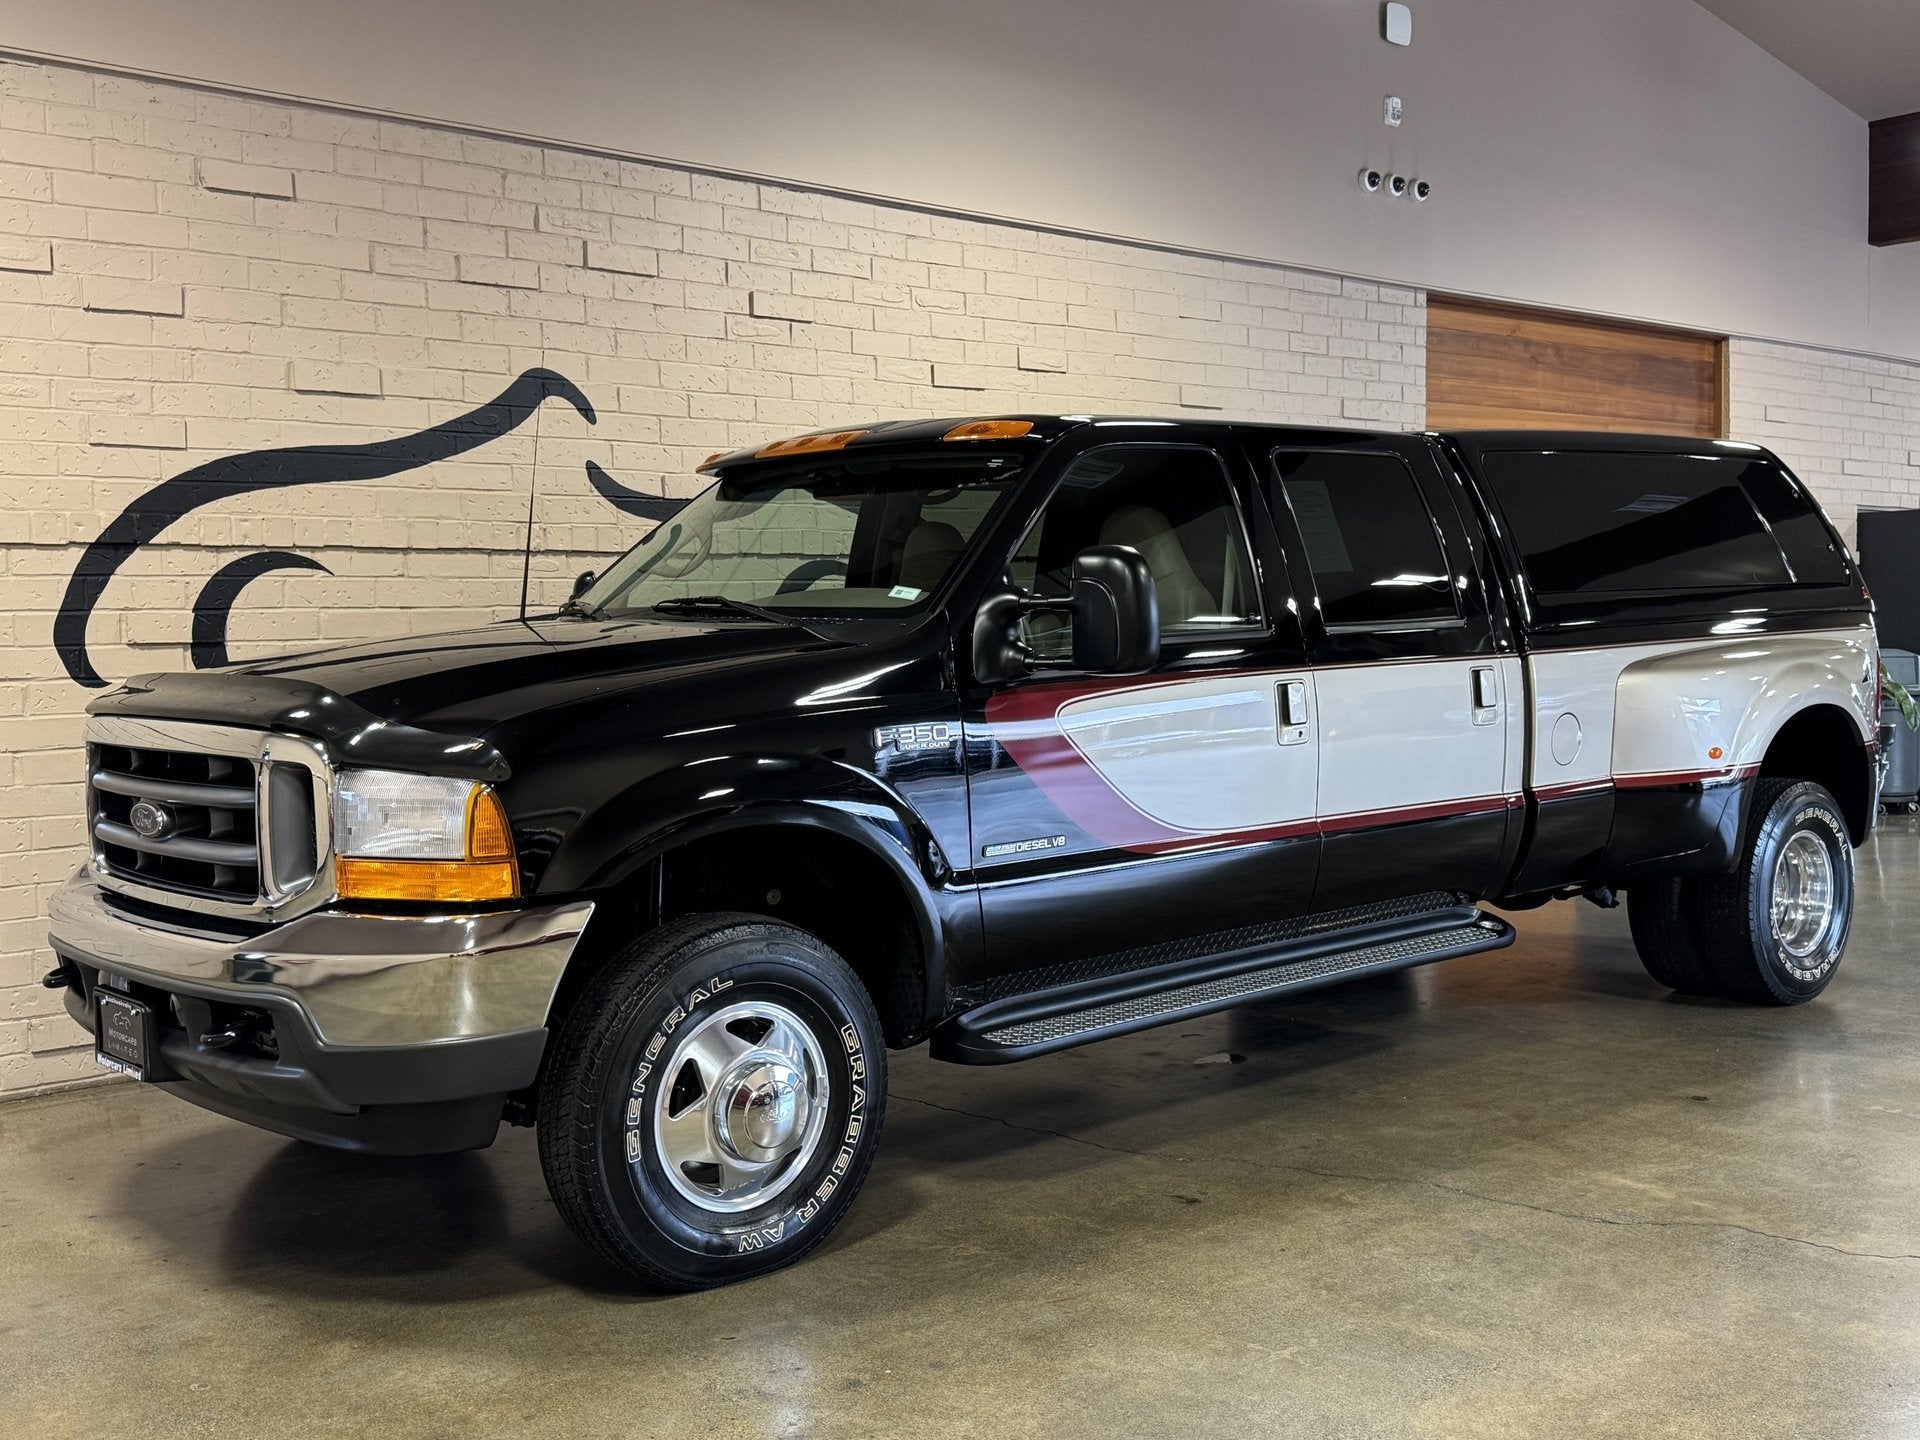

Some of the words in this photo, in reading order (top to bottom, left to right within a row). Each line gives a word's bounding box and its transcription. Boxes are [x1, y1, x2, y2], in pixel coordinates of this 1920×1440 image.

[928, 740, 950, 749] DUTY
[1016, 839, 1051, 852] DIESEL
[1052, 835, 1066, 847] V8
[1794, 807, 1847, 861] GENERAL
[626, 976, 734, 1165] GENERAL
[796, 1023, 866, 1224] GRABBER
[738, 1220, 785, 1252] AW
